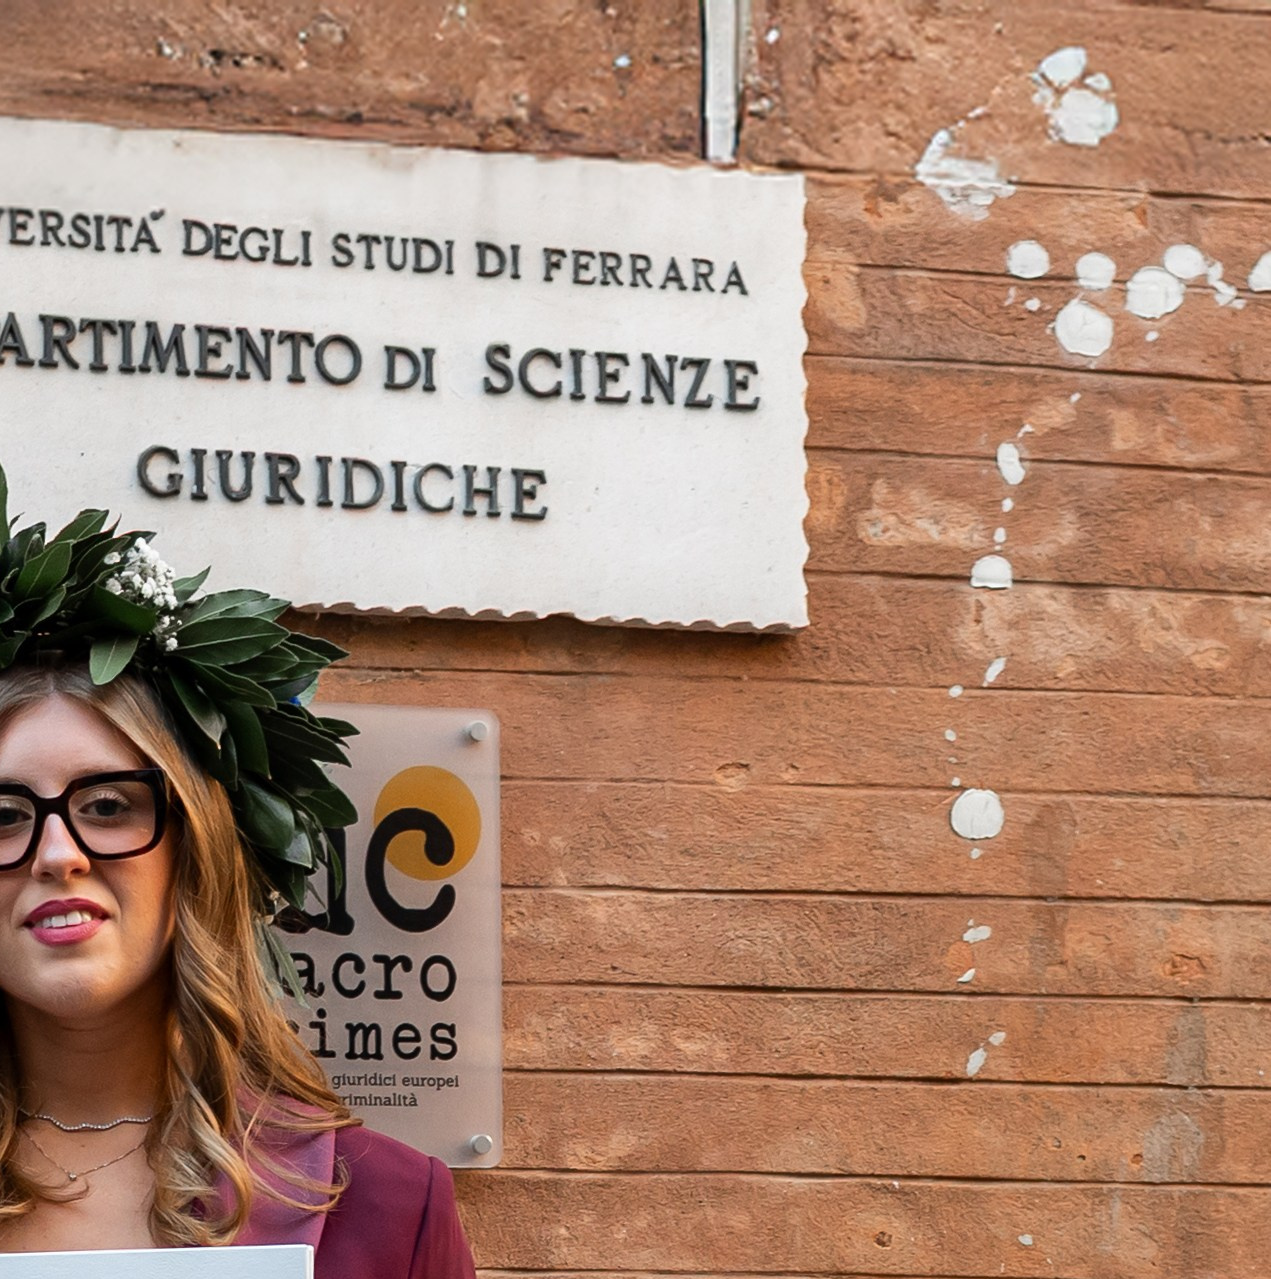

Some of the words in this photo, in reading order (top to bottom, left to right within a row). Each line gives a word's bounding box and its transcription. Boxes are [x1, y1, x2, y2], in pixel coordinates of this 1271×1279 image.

[182, 218, 313, 268] DEGLI
[330, 231, 456, 277] STUDI
[476, 242, 522, 281] DI
[541, 246, 750, 297] FERRARA
[383, 344, 437, 393] DI
[482, 342, 762, 413] SCIENZE
[136, 444, 550, 522] GIURIDICHE
[283, 952, 457, 1002] acro
[332, 1073, 397, 1090] giuridici
[402, 1074, 459, 1091] europei
[340, 1092, 418, 1108] riminalità
